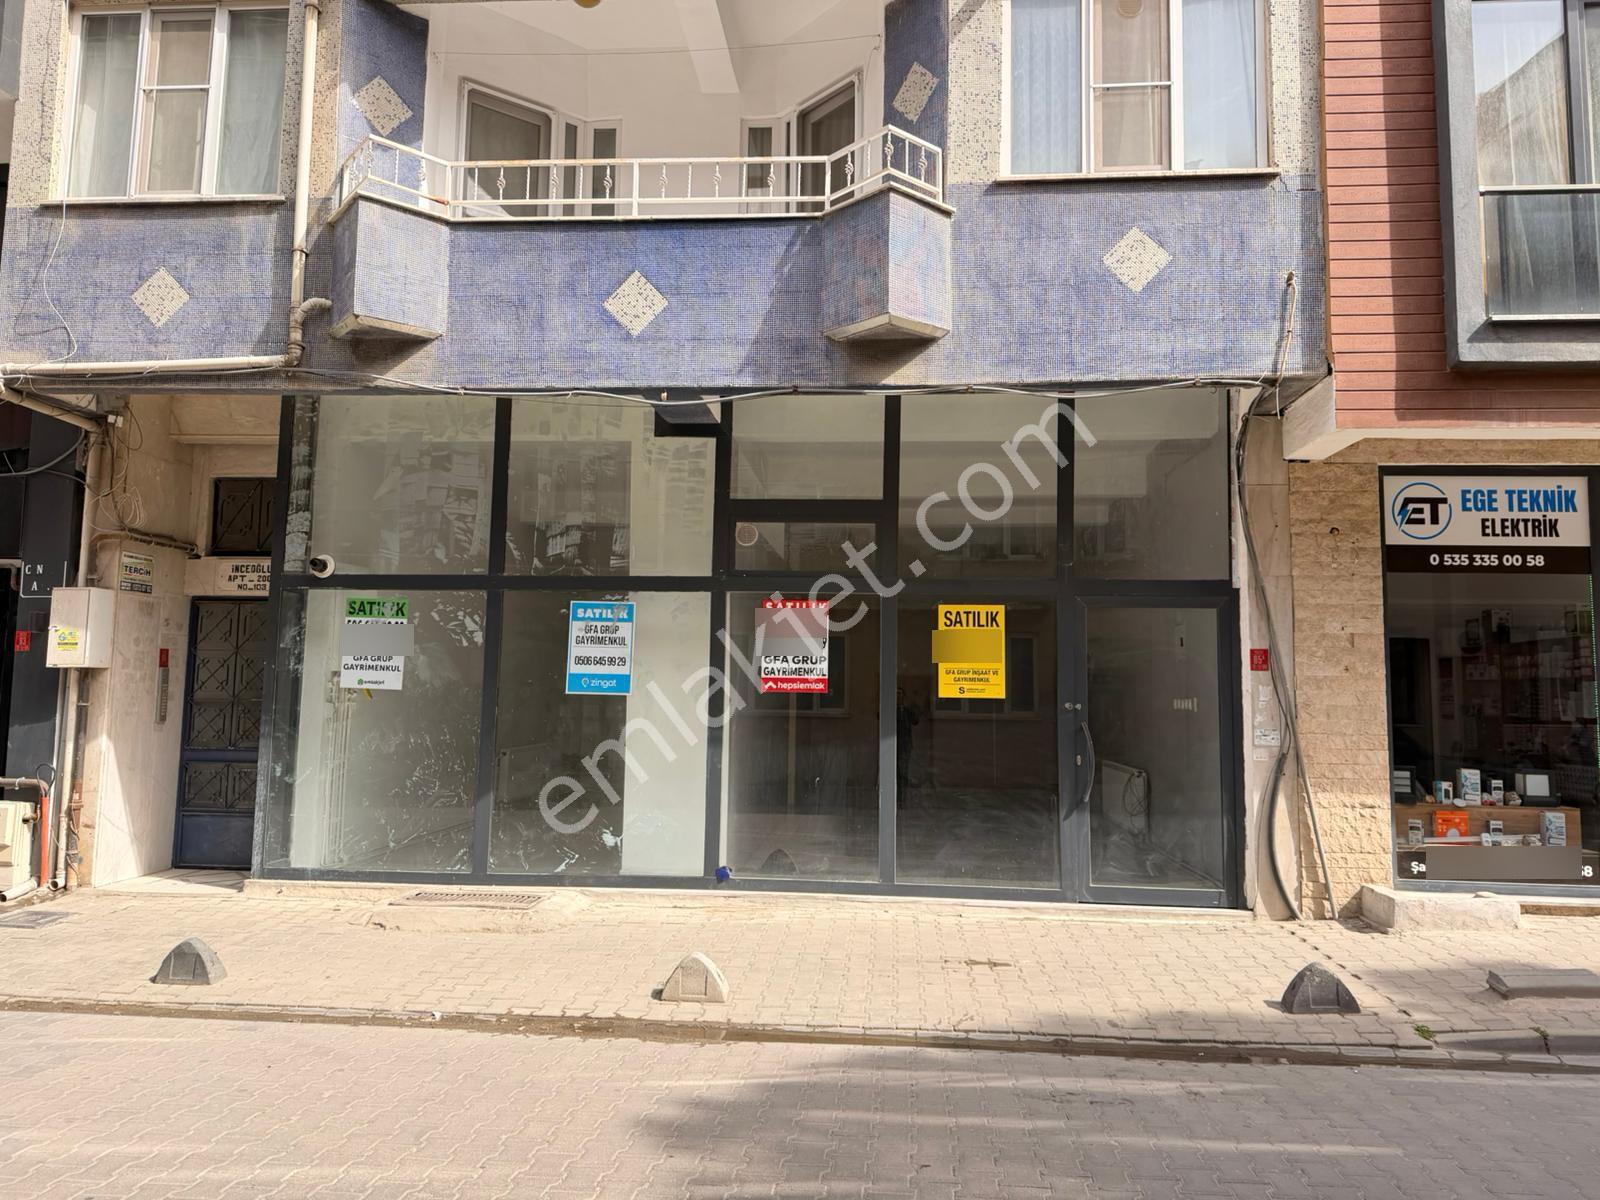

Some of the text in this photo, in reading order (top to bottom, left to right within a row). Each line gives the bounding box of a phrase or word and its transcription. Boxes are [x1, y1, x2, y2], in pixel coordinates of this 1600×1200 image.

[1460, 485, 1578, 513] EGE TEKNİK
[1481, 515, 1560, 538] ELEKTRİK
[1429, 553, 1545, 567] 0 535 335 00 58
[227, 574, 247, 582] APT
[943, 610, 1000, 628] SATILIK
[584, 624, 598, 634] GFA
[575, 635, 627, 646] GAYRİMENKUL
[574, 655, 626, 667] 0506 645 99 29
[792, 655, 827, 665] GRUP
[343, 663, 401, 672] GAYRİMENKUL
[590, 677, 617, 689] zingat
[777, 681, 825, 690] hepsiemlak
